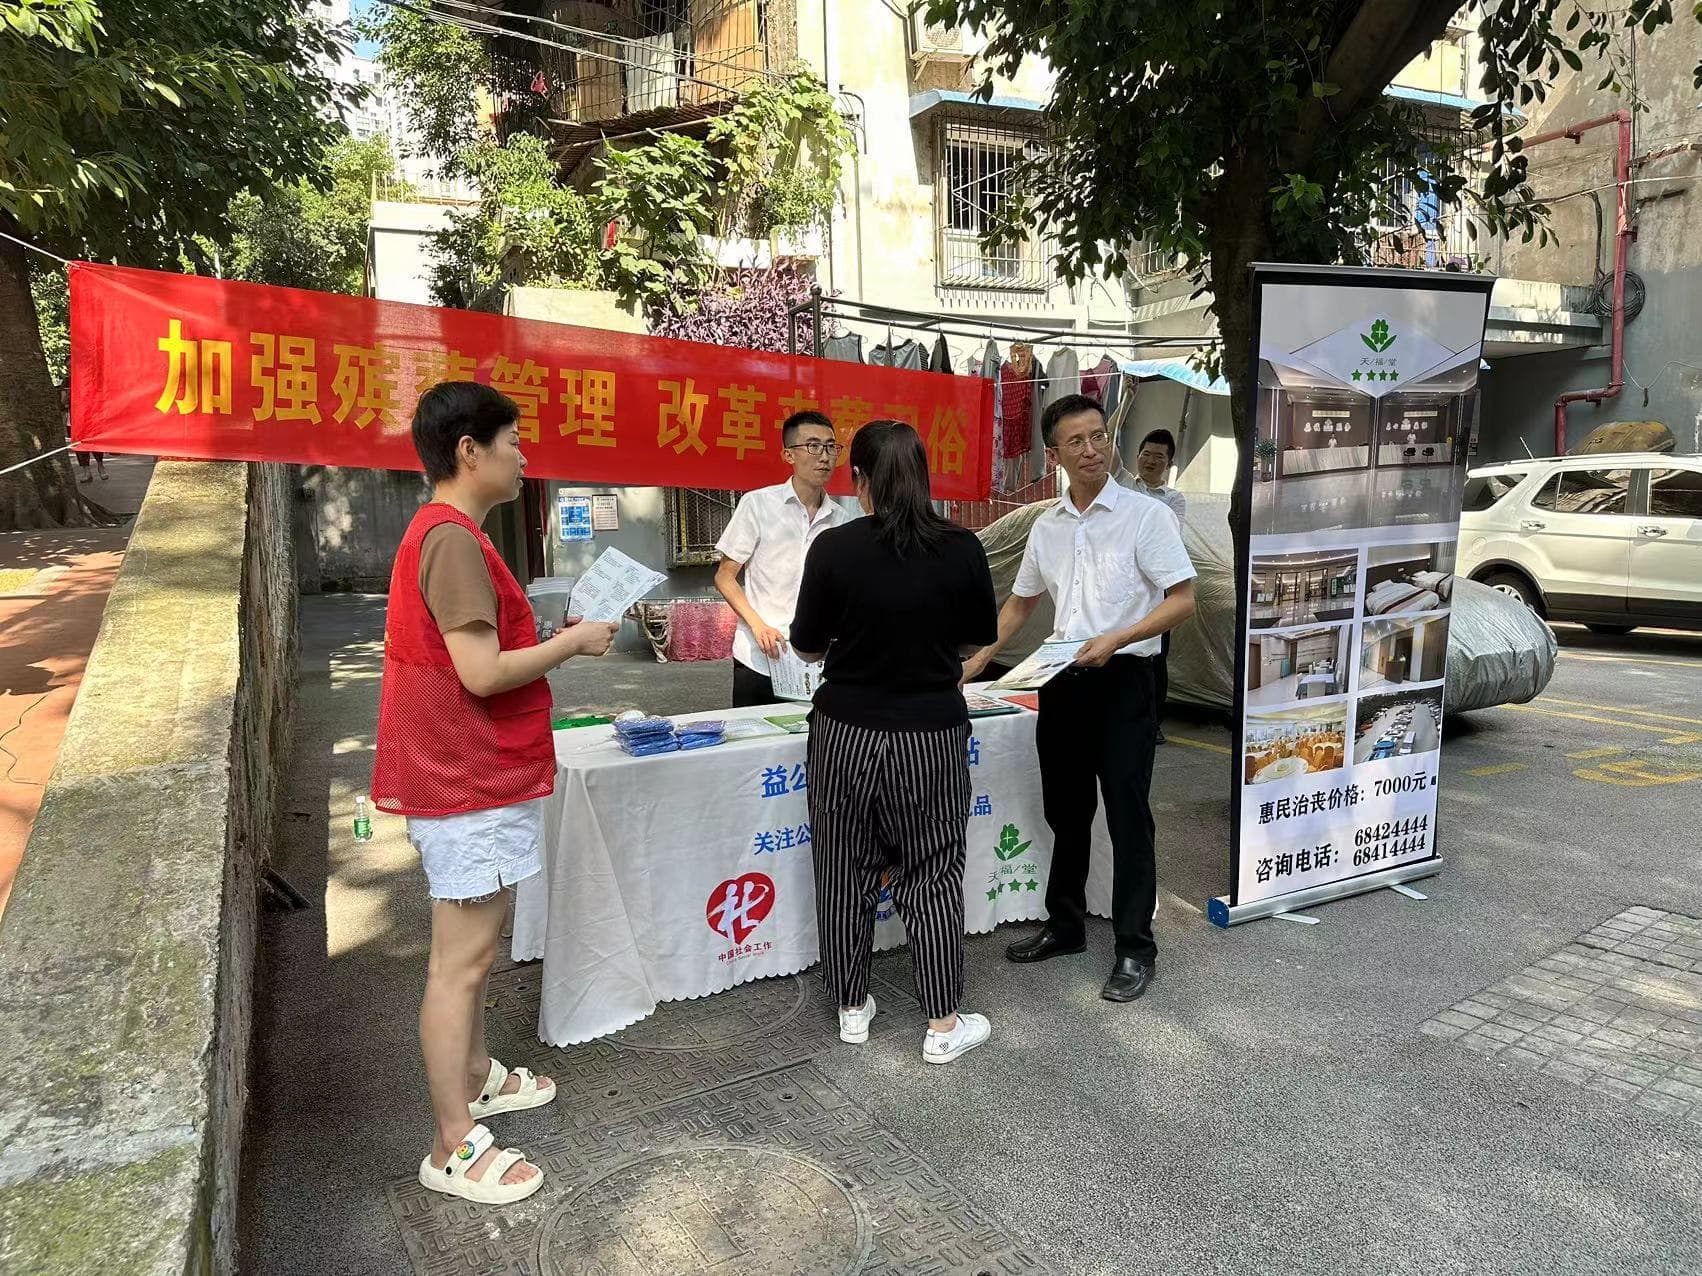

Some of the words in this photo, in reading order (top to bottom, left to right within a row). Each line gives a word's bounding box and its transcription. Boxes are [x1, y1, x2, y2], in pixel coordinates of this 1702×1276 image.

[1354, 814, 1428, 847] 68424444
[1353, 833, 1426, 867] 68414444
[718, 941, 773, 962] 中国社会工作
